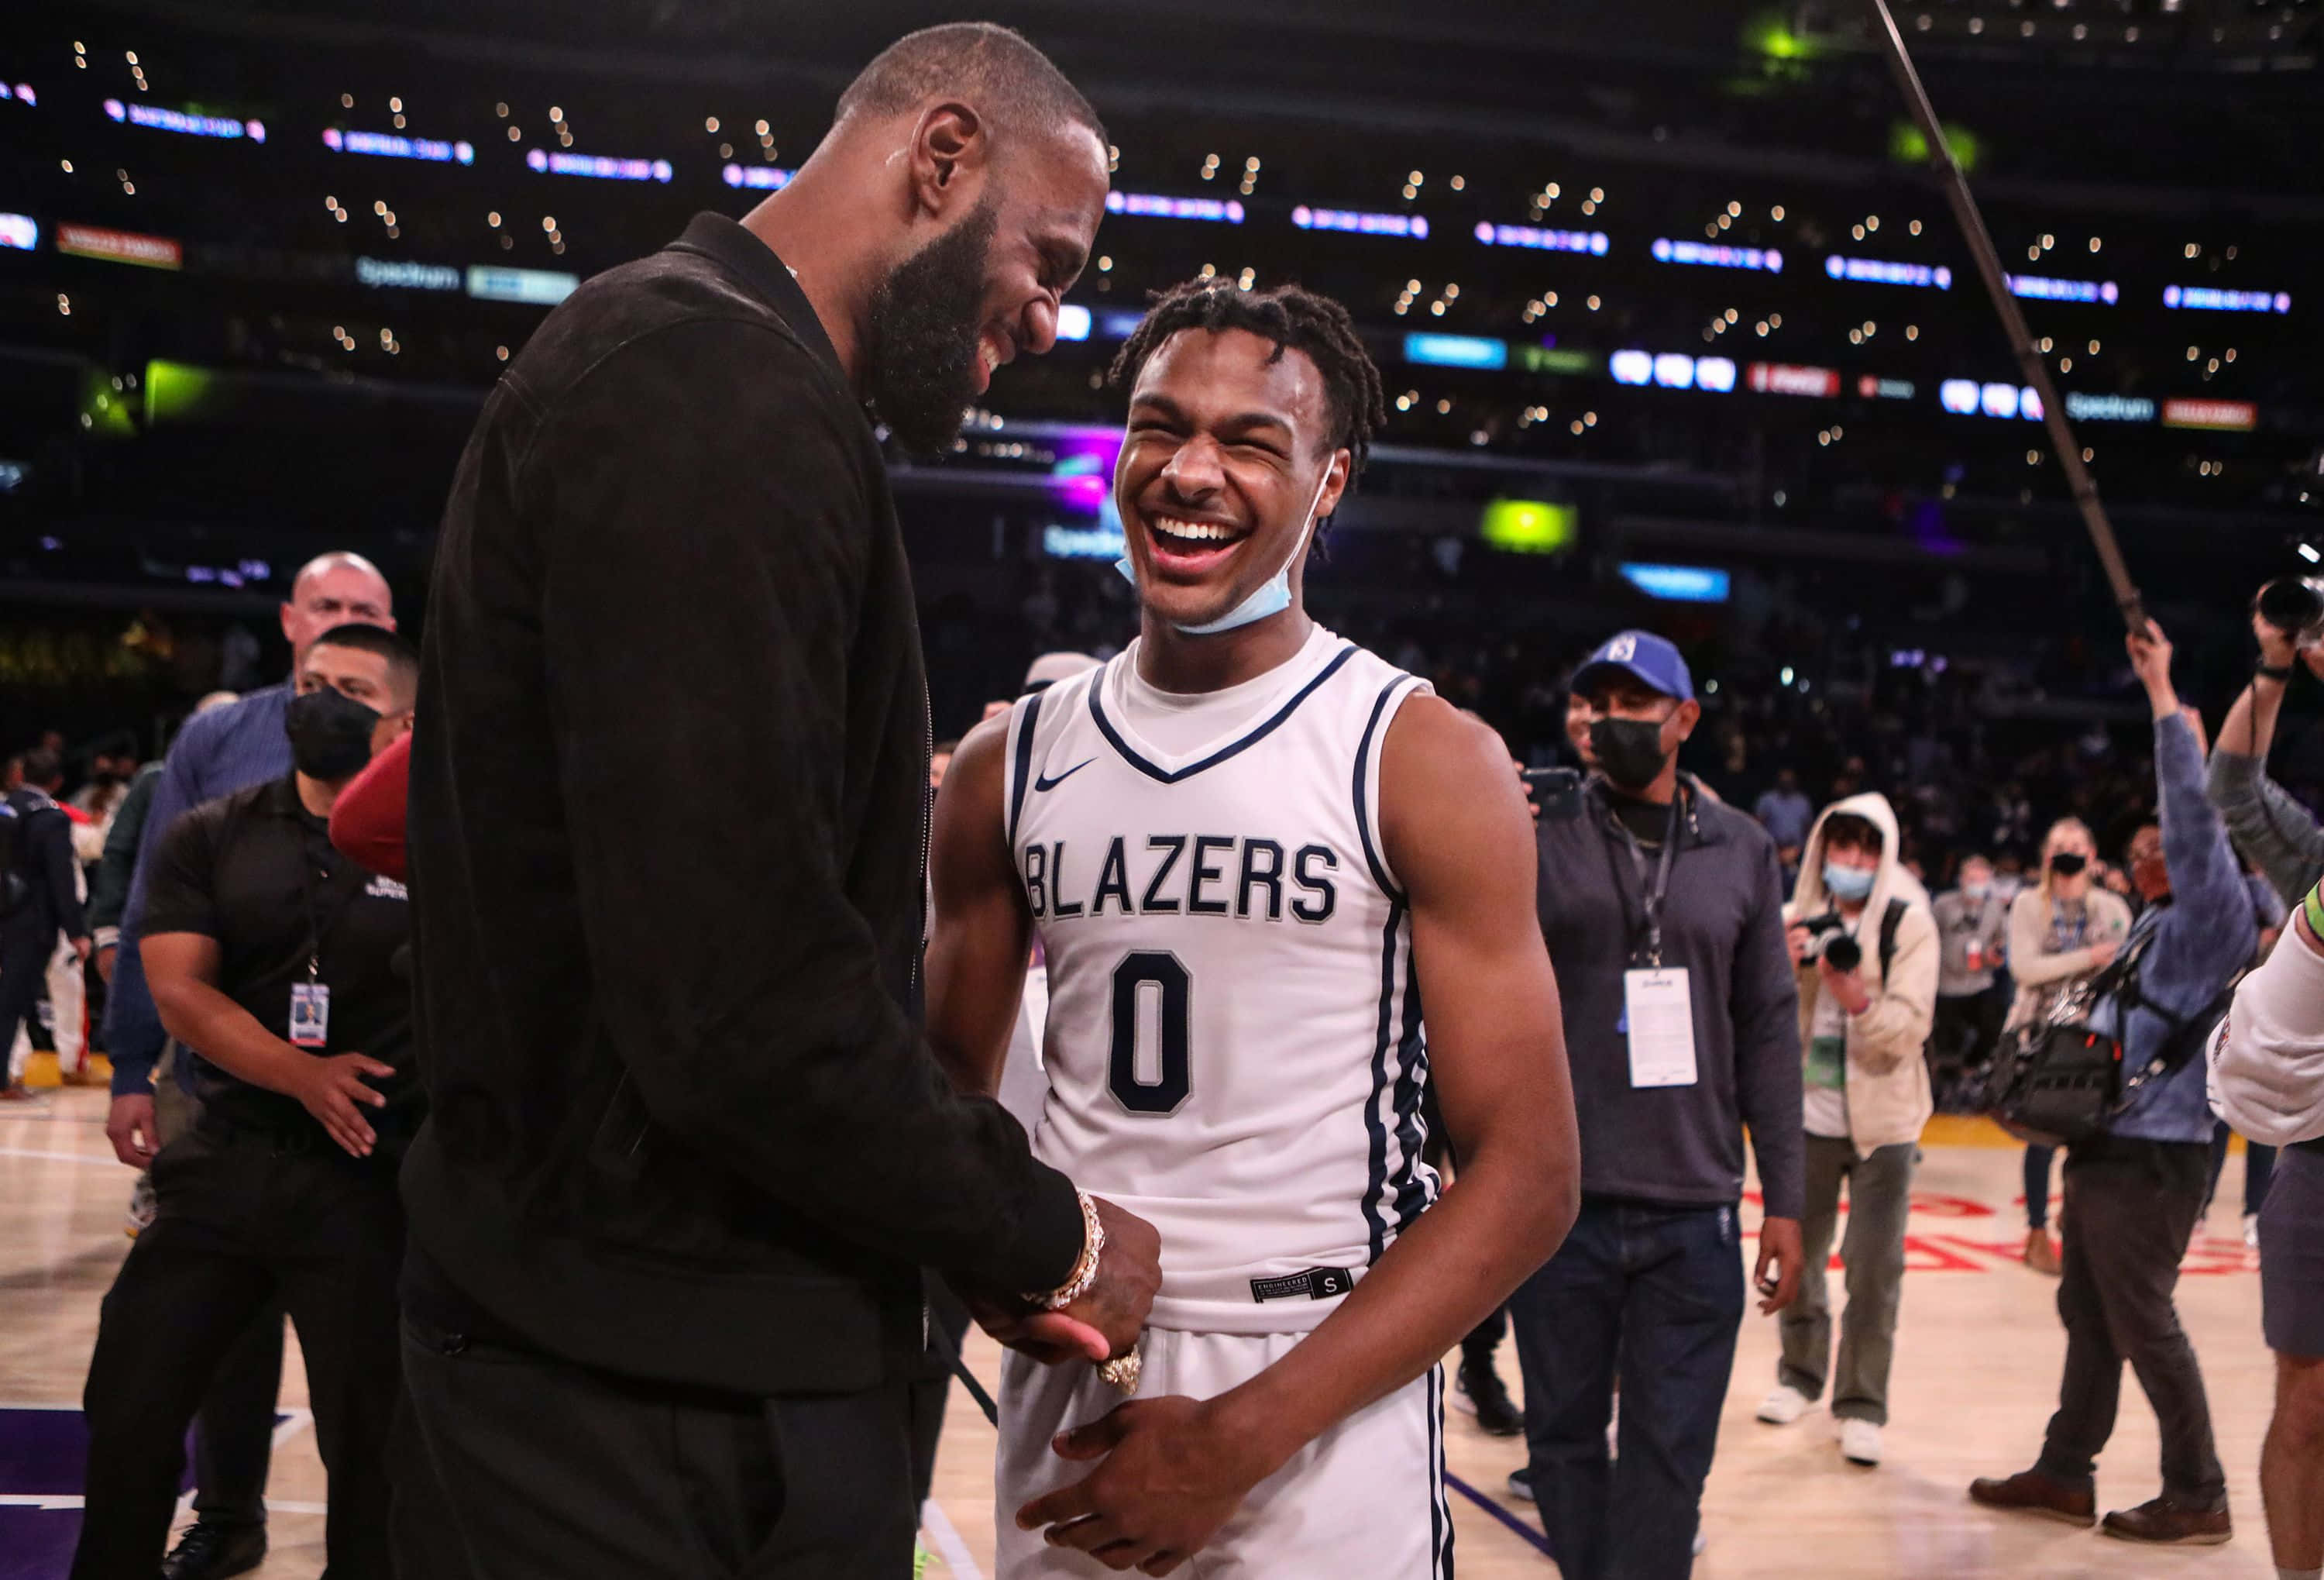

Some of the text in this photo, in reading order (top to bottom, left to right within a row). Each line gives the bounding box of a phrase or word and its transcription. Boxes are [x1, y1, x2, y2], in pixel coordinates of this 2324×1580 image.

[1026, 834, 1339, 924] BLAZERS
[1105, 949, 1194, 1119] 0
[1258, 1277, 1307, 1290] ENGINEERED
[1324, 1277, 1337, 1293] S
